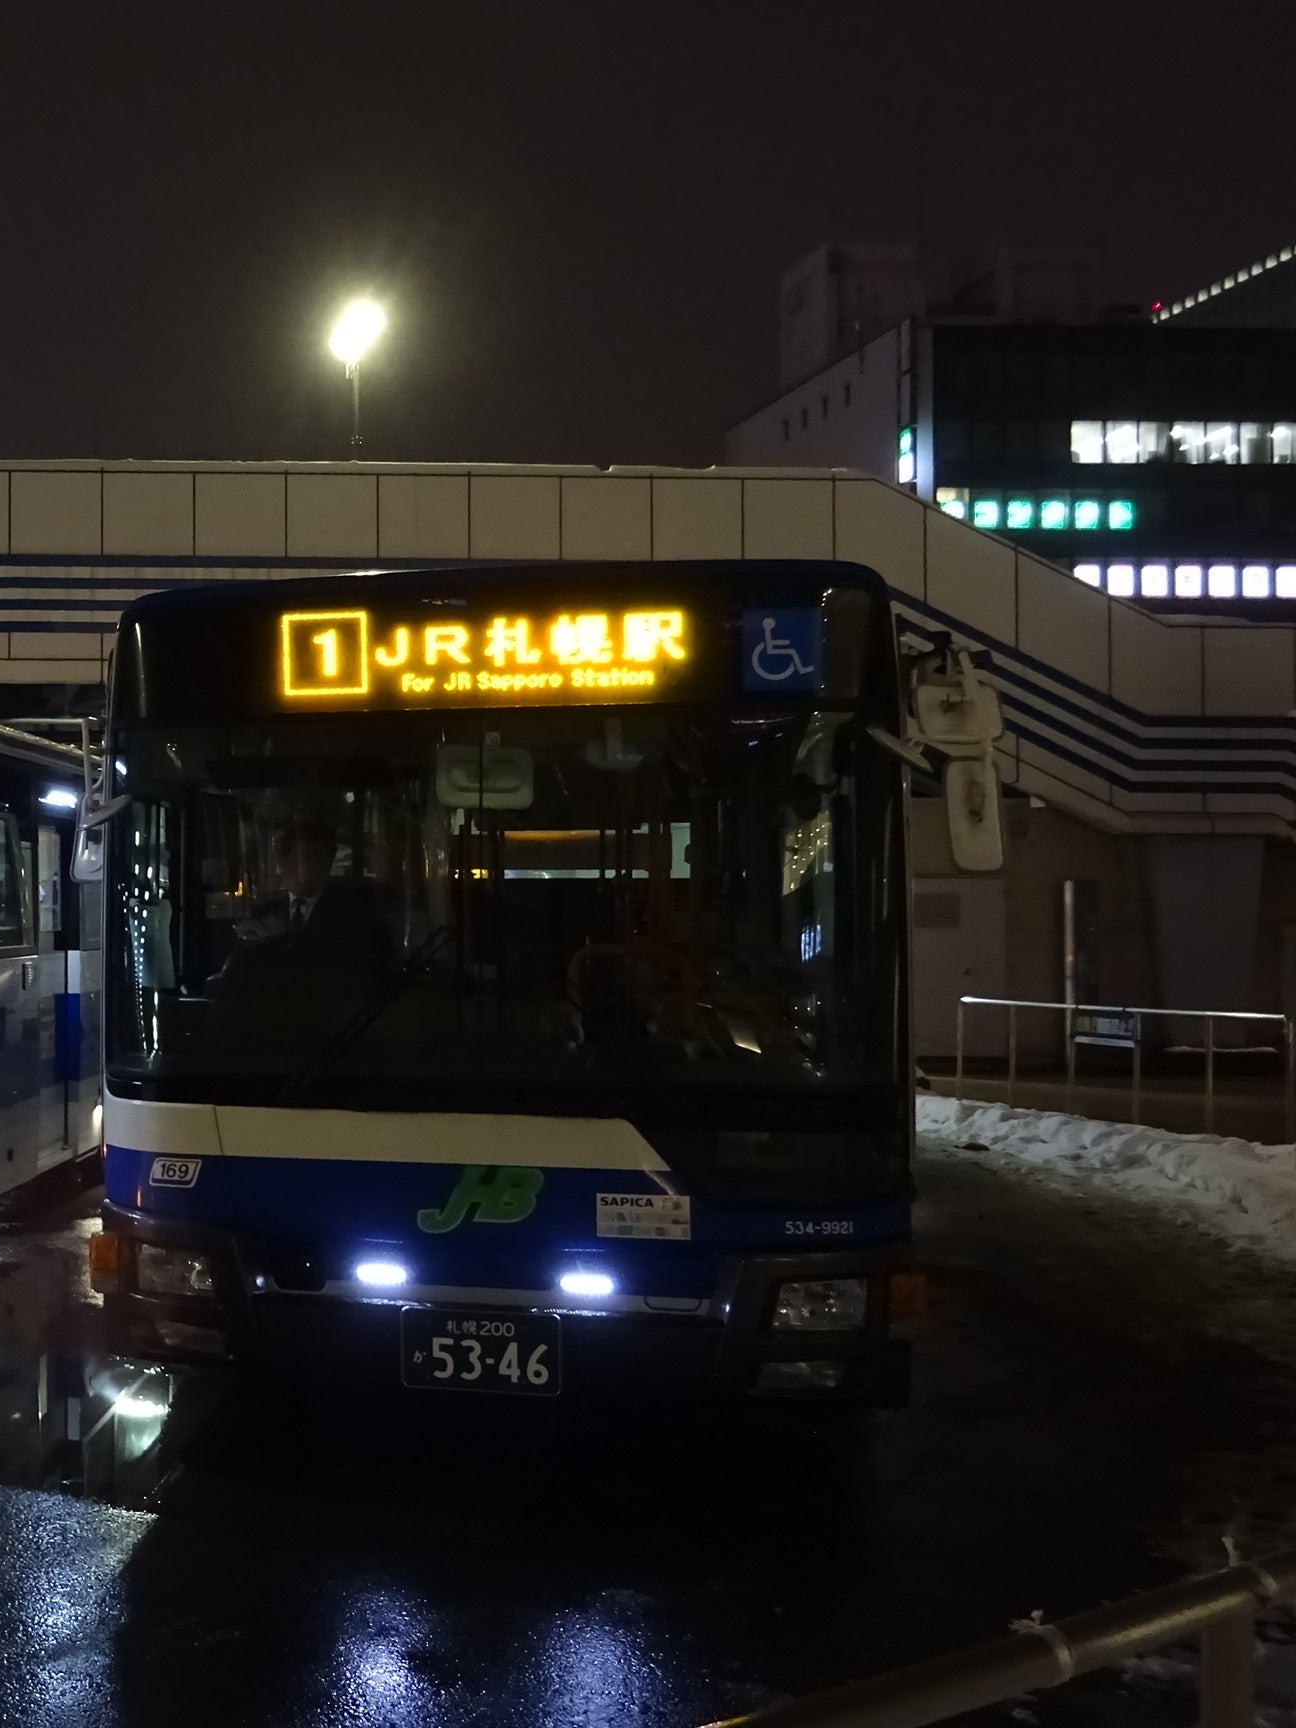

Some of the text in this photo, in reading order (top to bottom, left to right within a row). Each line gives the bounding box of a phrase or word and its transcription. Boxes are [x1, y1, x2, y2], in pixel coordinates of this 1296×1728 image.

[313, 629, 337, 677] 1
[402, 668, 654, 692] For JR Sapporo Station
[160, 1163, 189, 1179] 169
[600, 1197, 654, 1208] SAPICA
[785, 1221, 854, 1234] 534-9921
[432, 1337, 549, 1385] 53-46
